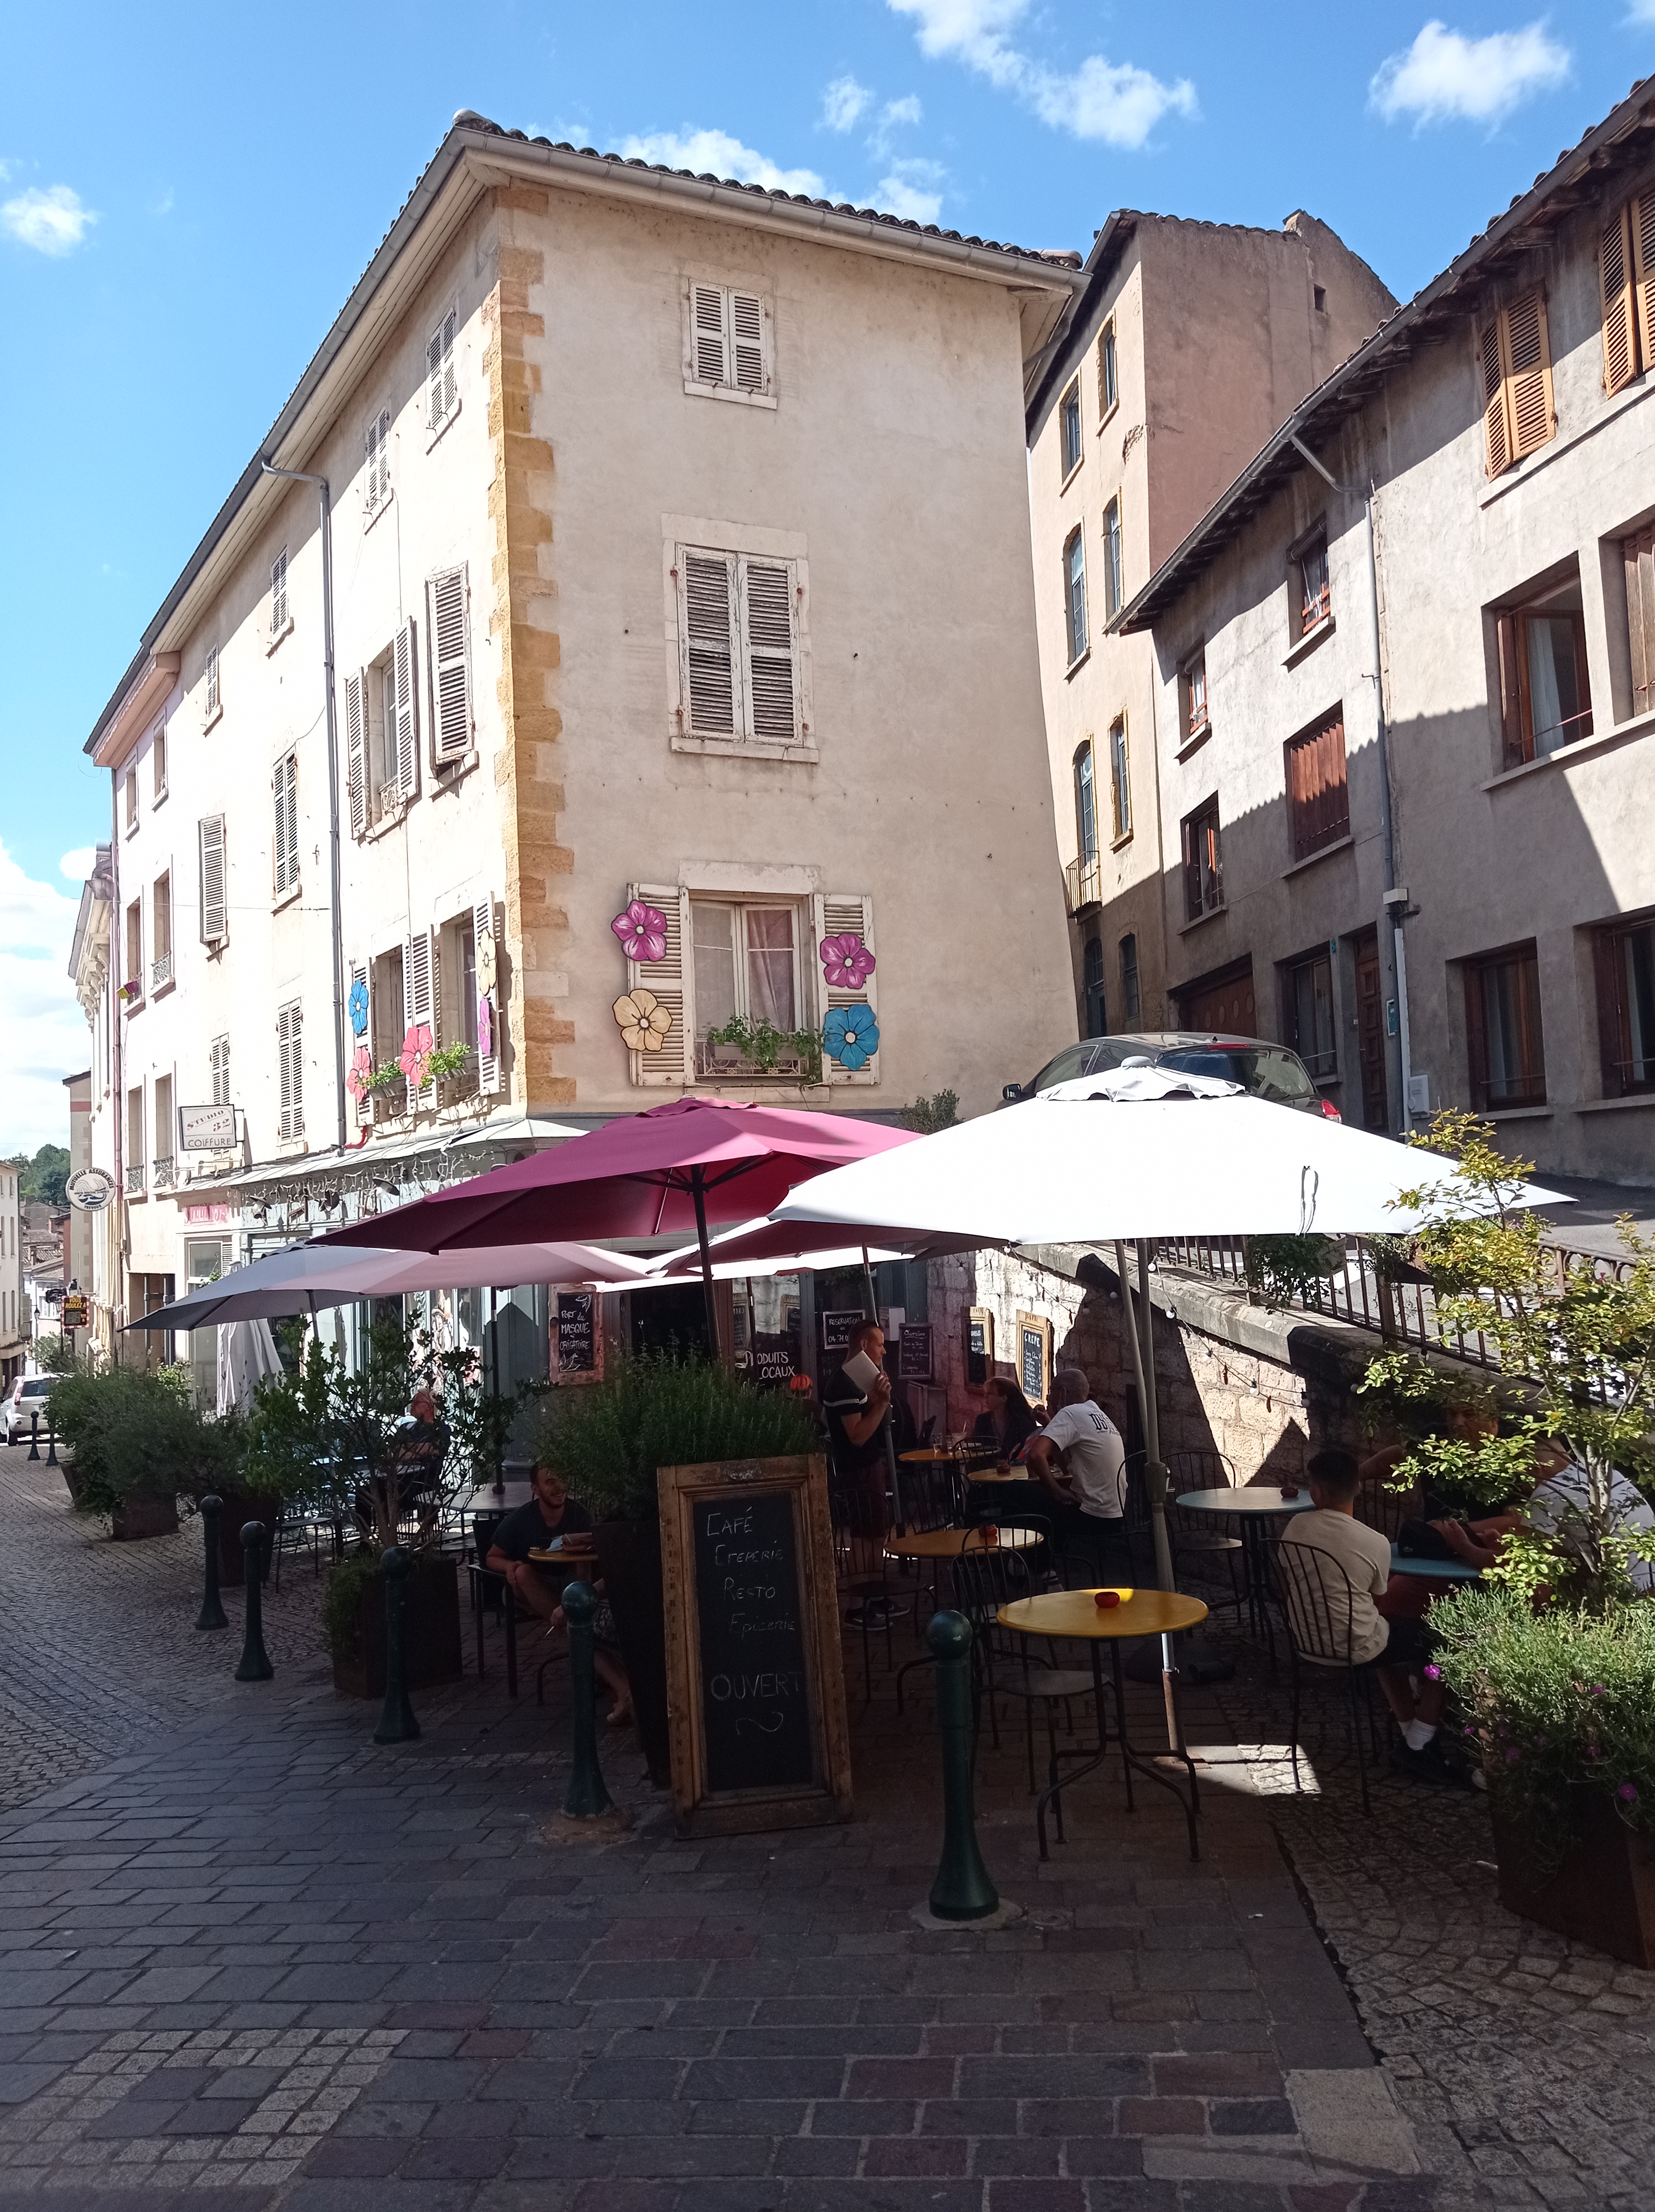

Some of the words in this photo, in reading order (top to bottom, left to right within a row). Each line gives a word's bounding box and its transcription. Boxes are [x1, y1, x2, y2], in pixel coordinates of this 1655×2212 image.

[187, 1110, 223, 1130] STUDIO
[213, 1119, 230, 1131] 32
[188, 1138, 231, 1147] COIFFURE
[69, 1170, 87, 1191] MUTUELLE
[89, 1168, 114, 1189] ASSURANCES
[561, 1310, 576, 1319] PORT
[561, 1322, 590, 1334] MASQUE
[828, 1334, 849, 1343] 04.74.0
[1024, 1332, 1040, 1348] CREPE
[743, 1351, 789, 1367] PODUITS
[759, 1366, 795, 1379] OCAUX
[710, 1672, 802, 1701] OUVERT
